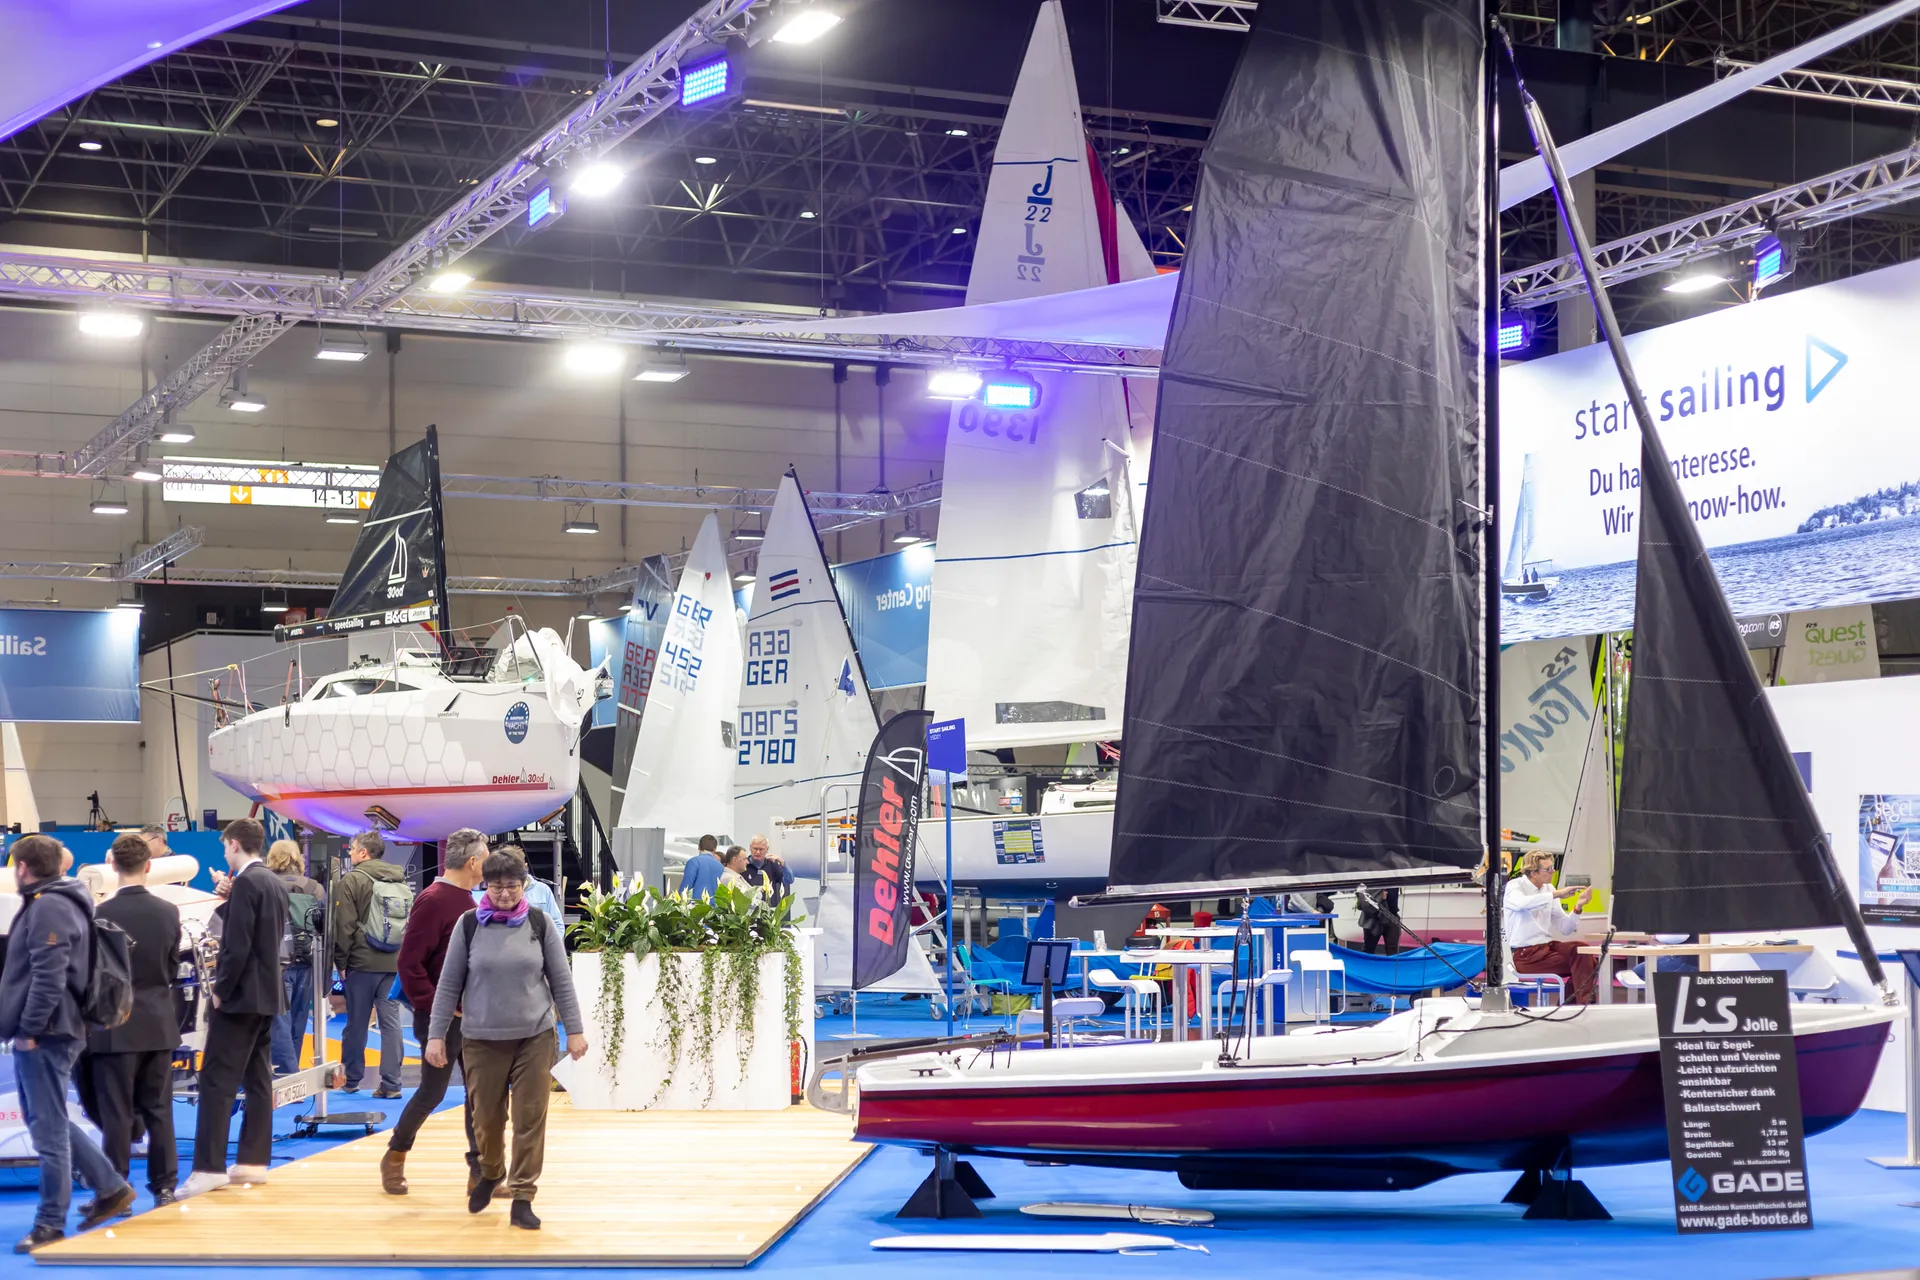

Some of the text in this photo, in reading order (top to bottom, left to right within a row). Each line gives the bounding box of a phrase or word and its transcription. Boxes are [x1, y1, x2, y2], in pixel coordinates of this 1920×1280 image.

[1025, 205, 1052, 223] 22
[1575, 364, 1786, 440] star sailing
[1589, 467, 1613, 496] Du
[1668, 446, 1756, 481] nteresse.
[1602, 484, 1786, 535] Wir now-how.
[676, 594, 713, 630] GER
[334, 618, 364, 632] speedsailing
[384, 609, 408, 625] B&G
[1769, 620, 1781, 631] RS
[1805, 620, 1867, 644] Quest
[625, 640, 657, 668] GER
[665, 641, 703, 679] 452
[746, 658, 789, 687] GER
[738, 738, 797, 766] 2780
[492, 774, 520, 784] Dehler
[1875, 799, 1914, 823] segel
[868, 775, 904, 947] Dehler
[1697, 976, 1774, 985] Dark School Version
[1743, 1018, 1778, 1031] Jolle
[1675, 1041, 1754, 1051] -Ideal für Segel-
[1679, 1052, 1781, 1062] schulen und Vereine
[1677, 1064, 1777, 1074] -Leicht aufzurichten
[1678, 1077, 1732, 1086] -unsinkbar
[1680, 1087, 1776, 1098] -Kentersicher dank
[1684, 1102, 1761, 1112] Ballastschwert
[1683, 1121, 1710, 1129] Länge:
[1771, 1118, 1777, 1126] 5
[1684, 1130, 1711, 1138] Breite:
[1761, 1129, 1778, 1137] 1,72
[1685, 1141, 1734, 1149] Segelfläche:
[1686, 1149, 1790, 1159] Gewicht: 200 Kg
[1712, 1172, 1805, 1193] GADE
[1680, 1201, 1806, 1212] GADE-Bootsbau Kunststofftechnik GmbH
[1681, 1212, 1808, 1229] www.gade-boote.de
